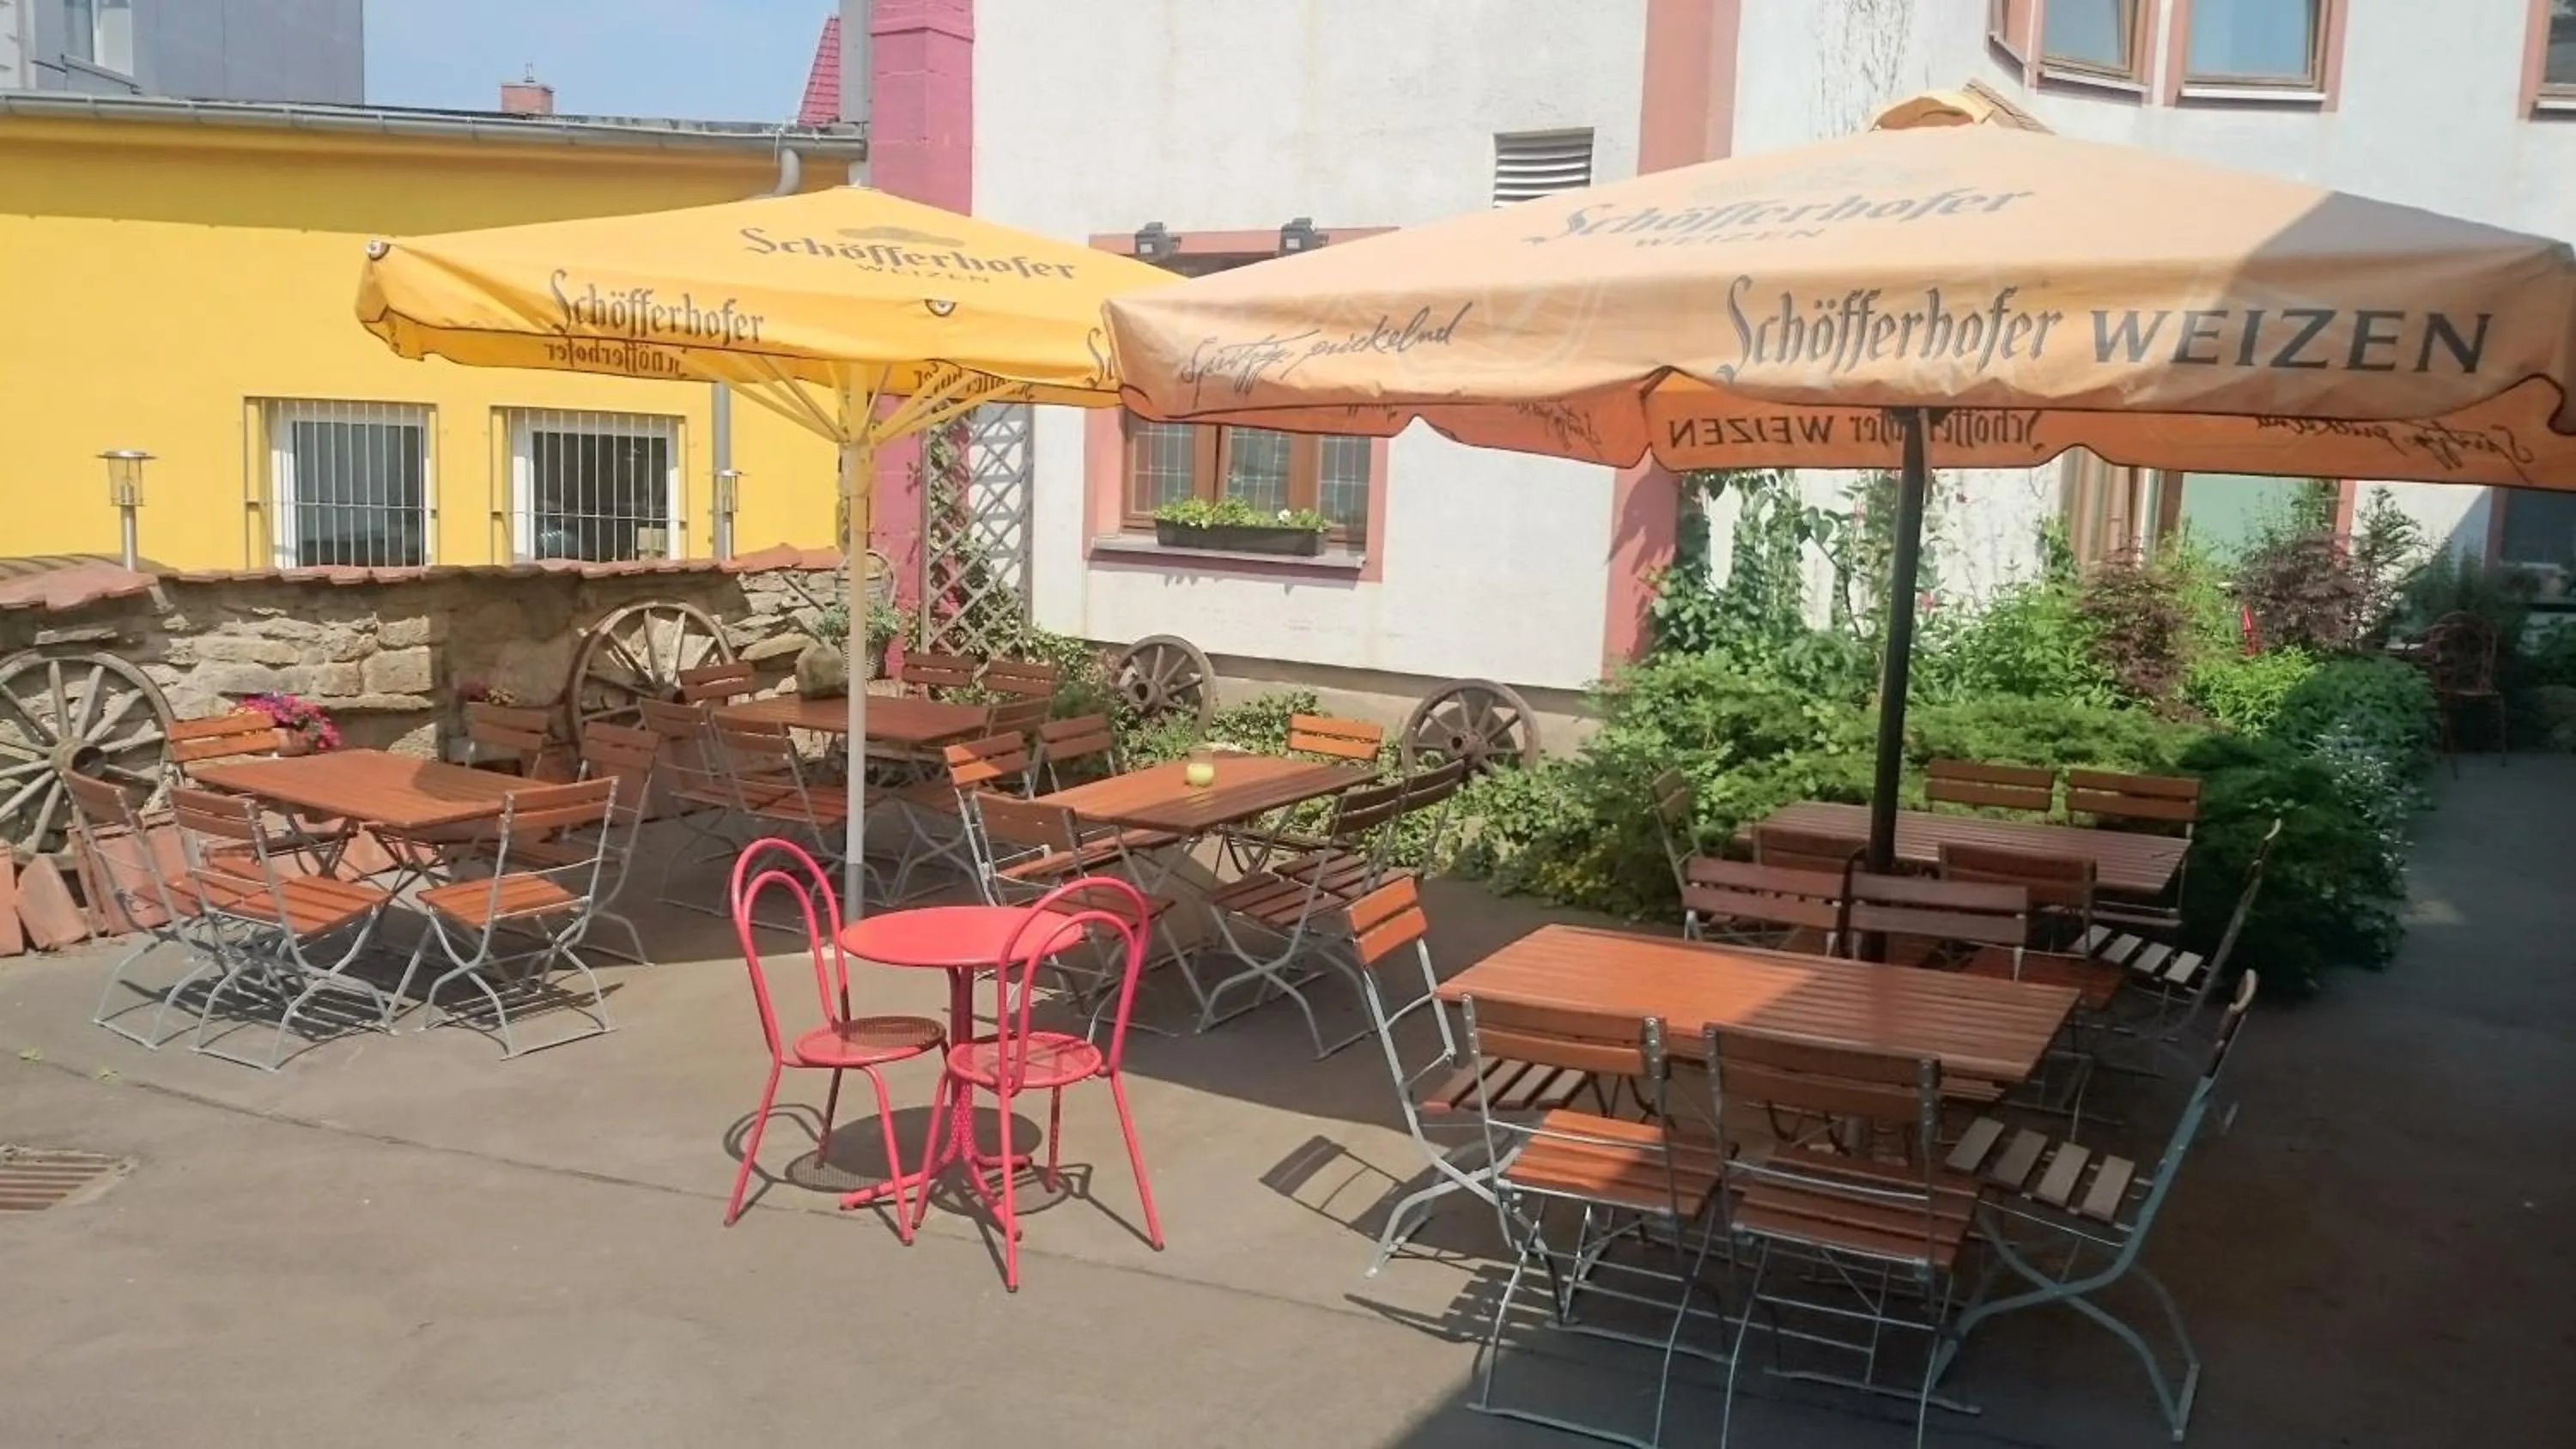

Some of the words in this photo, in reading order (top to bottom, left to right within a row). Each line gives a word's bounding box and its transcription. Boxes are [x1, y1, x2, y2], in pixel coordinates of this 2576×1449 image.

[1521, 187, 2035, 245] Schöfferhofer
[1635, 228, 1826, 246] WEIZEN
[739, 227, 1076, 279] Schöfferhofer
[858, 264, 991, 283] WEIZEN
[550, 268, 764, 345] Schöfferhofer
[1716, 274, 2064, 384] Schöfferhofer
[2090, 308, 2492, 374] WEIZEN
